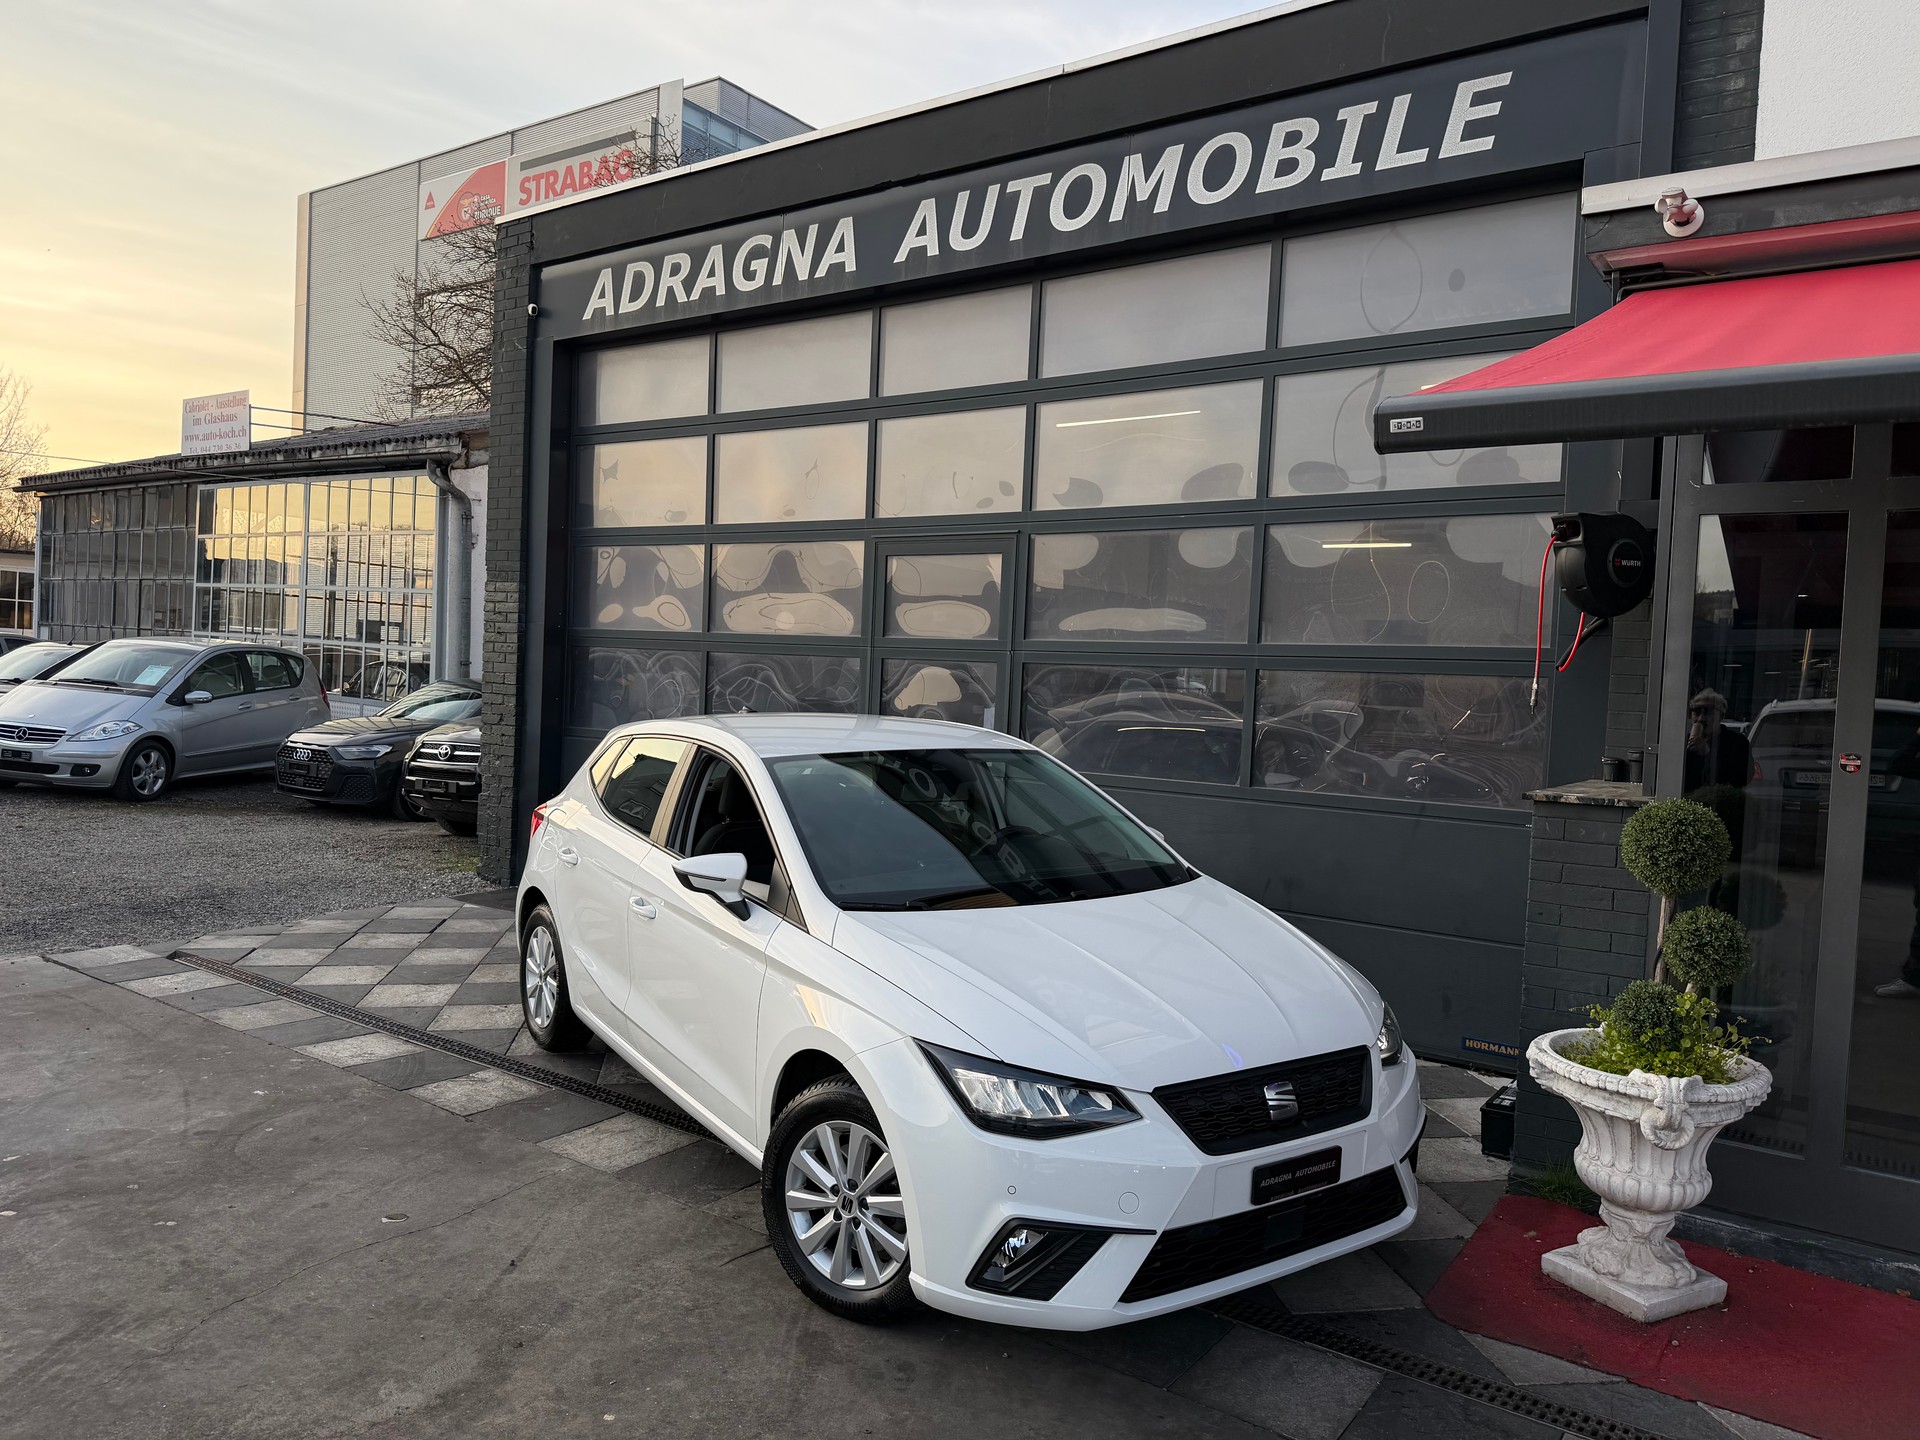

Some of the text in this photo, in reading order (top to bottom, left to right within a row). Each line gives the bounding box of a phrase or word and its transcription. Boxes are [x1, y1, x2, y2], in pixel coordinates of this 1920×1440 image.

[518, 149, 634, 206] STRABAG
[582, 71, 1514, 321] ADRAGNA AUTOMOBILE
[215, 395, 247, 410] Ausstellung
[192, 411, 238, 427] im Glashaus
[184, 425, 247, 442] www.auto-koch.ch
[1259, 1159, 1338, 1188] ADRAGNA AUTOMOBILE
